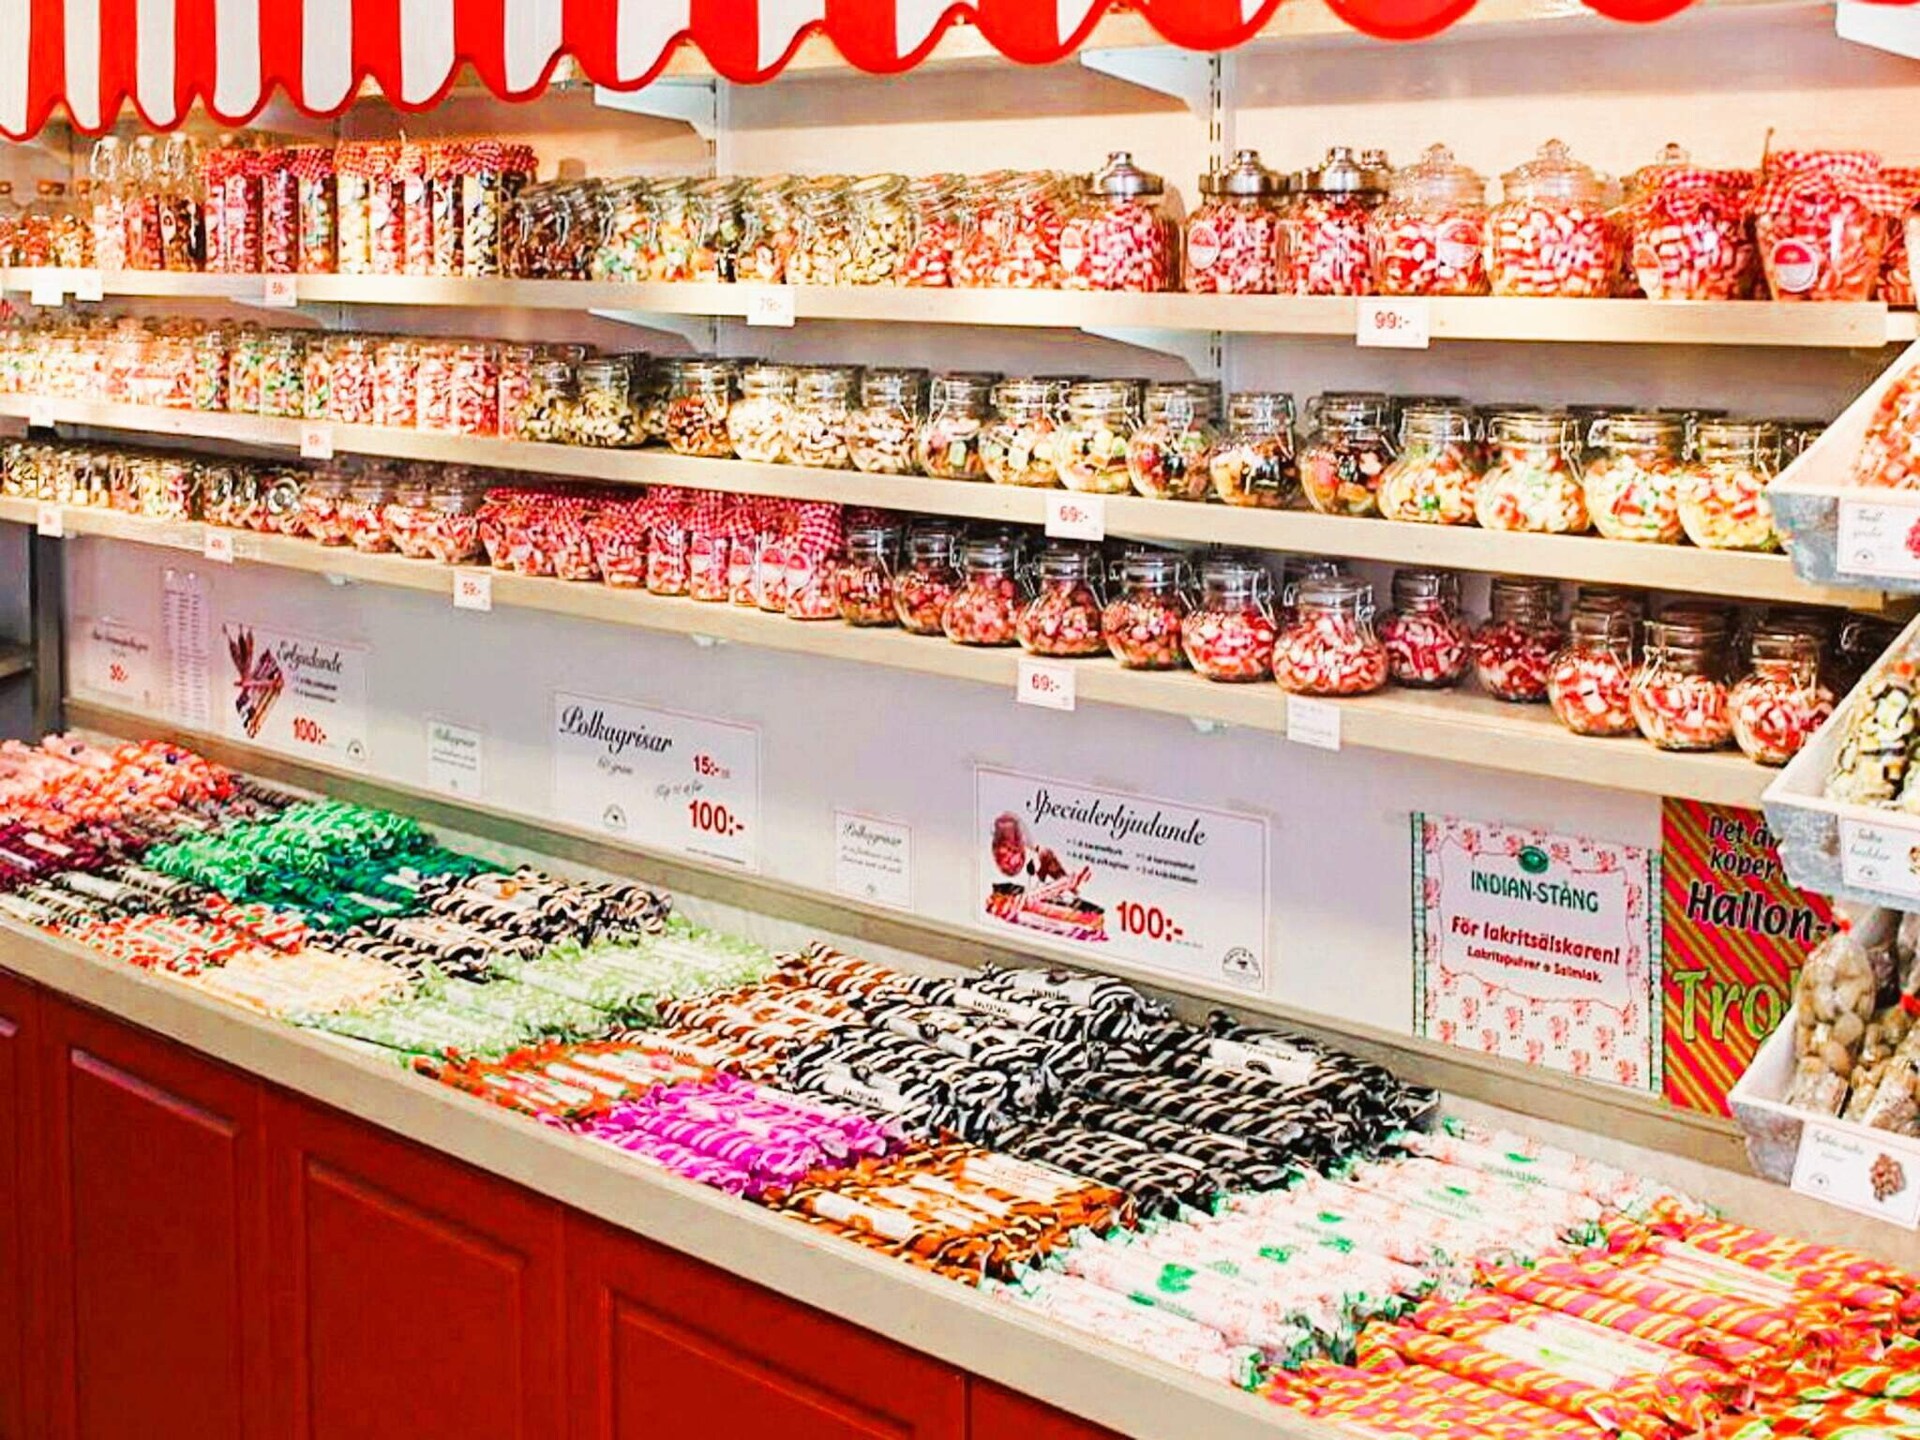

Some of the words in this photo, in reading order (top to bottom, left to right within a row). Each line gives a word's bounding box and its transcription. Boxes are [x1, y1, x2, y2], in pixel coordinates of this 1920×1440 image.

[1375, 310, 1410, 329] 99:-
[1060, 505, 1088, 522] 69:-
[1032, 673, 1061, 692] 69:-
[293, 717, 327, 744] 100:-
[559, 706, 673, 755] Polkagrisar
[693, 755, 720, 776] 15:-
[689, 800, 745, 836] 100:-
[1026, 789, 1208, 846] Specialerbjudande
[1709, 816, 1745, 843] Det
[1471, 869, 1599, 913] INDIAN-STÅNG
[1117, 901, 1183, 942] 100:-
[1451, 915, 1480, 938] För
[1483, 921, 1621, 966] lakritsälskaren!
